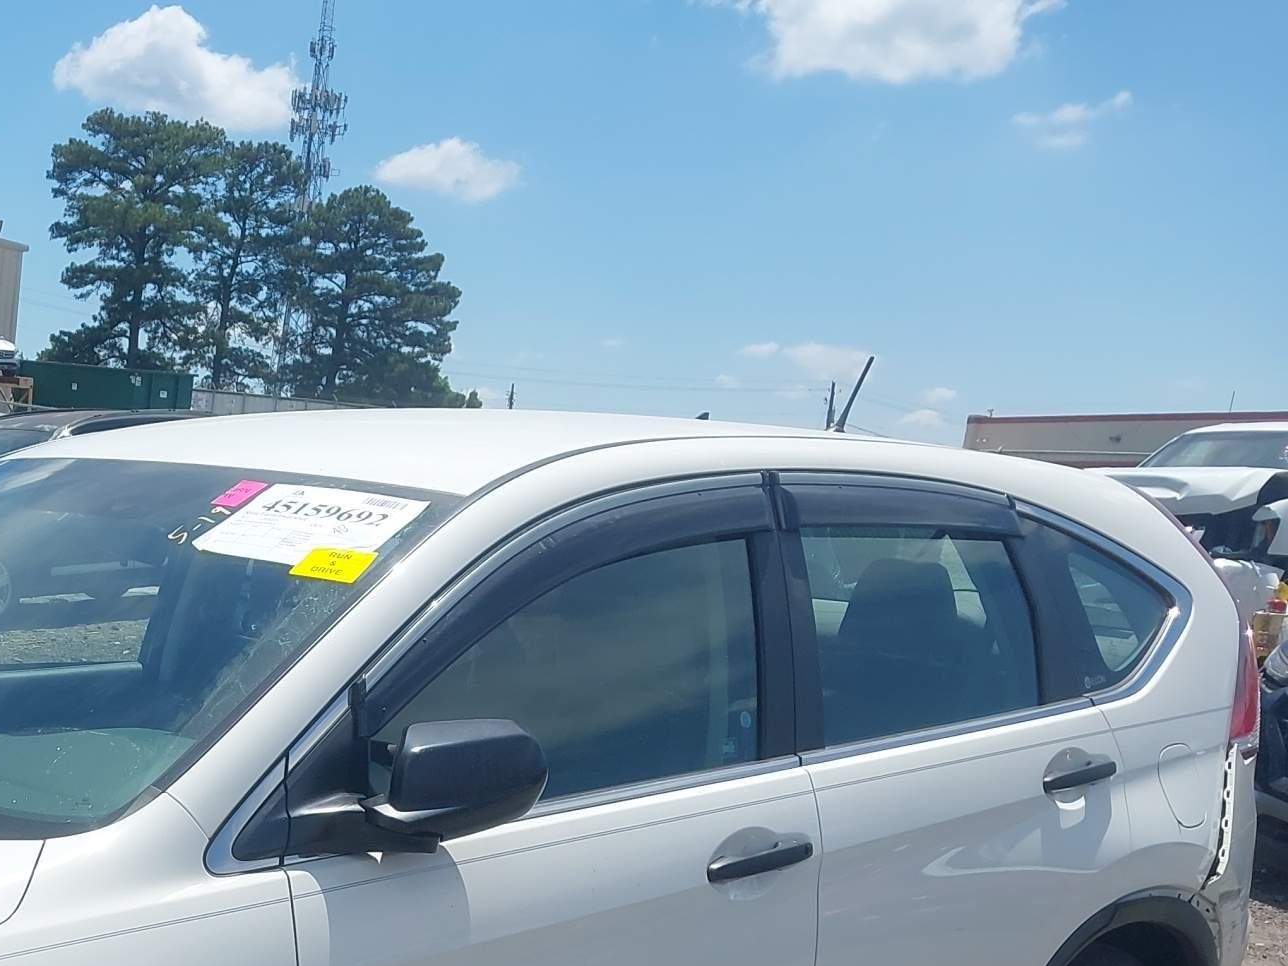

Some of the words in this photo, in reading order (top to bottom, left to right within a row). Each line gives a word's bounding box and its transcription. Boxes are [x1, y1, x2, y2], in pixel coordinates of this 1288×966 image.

[261, 499, 389, 527] 45159692
[328, 551, 353, 560] RUN
[309, 566, 344, 576] DRIVE
